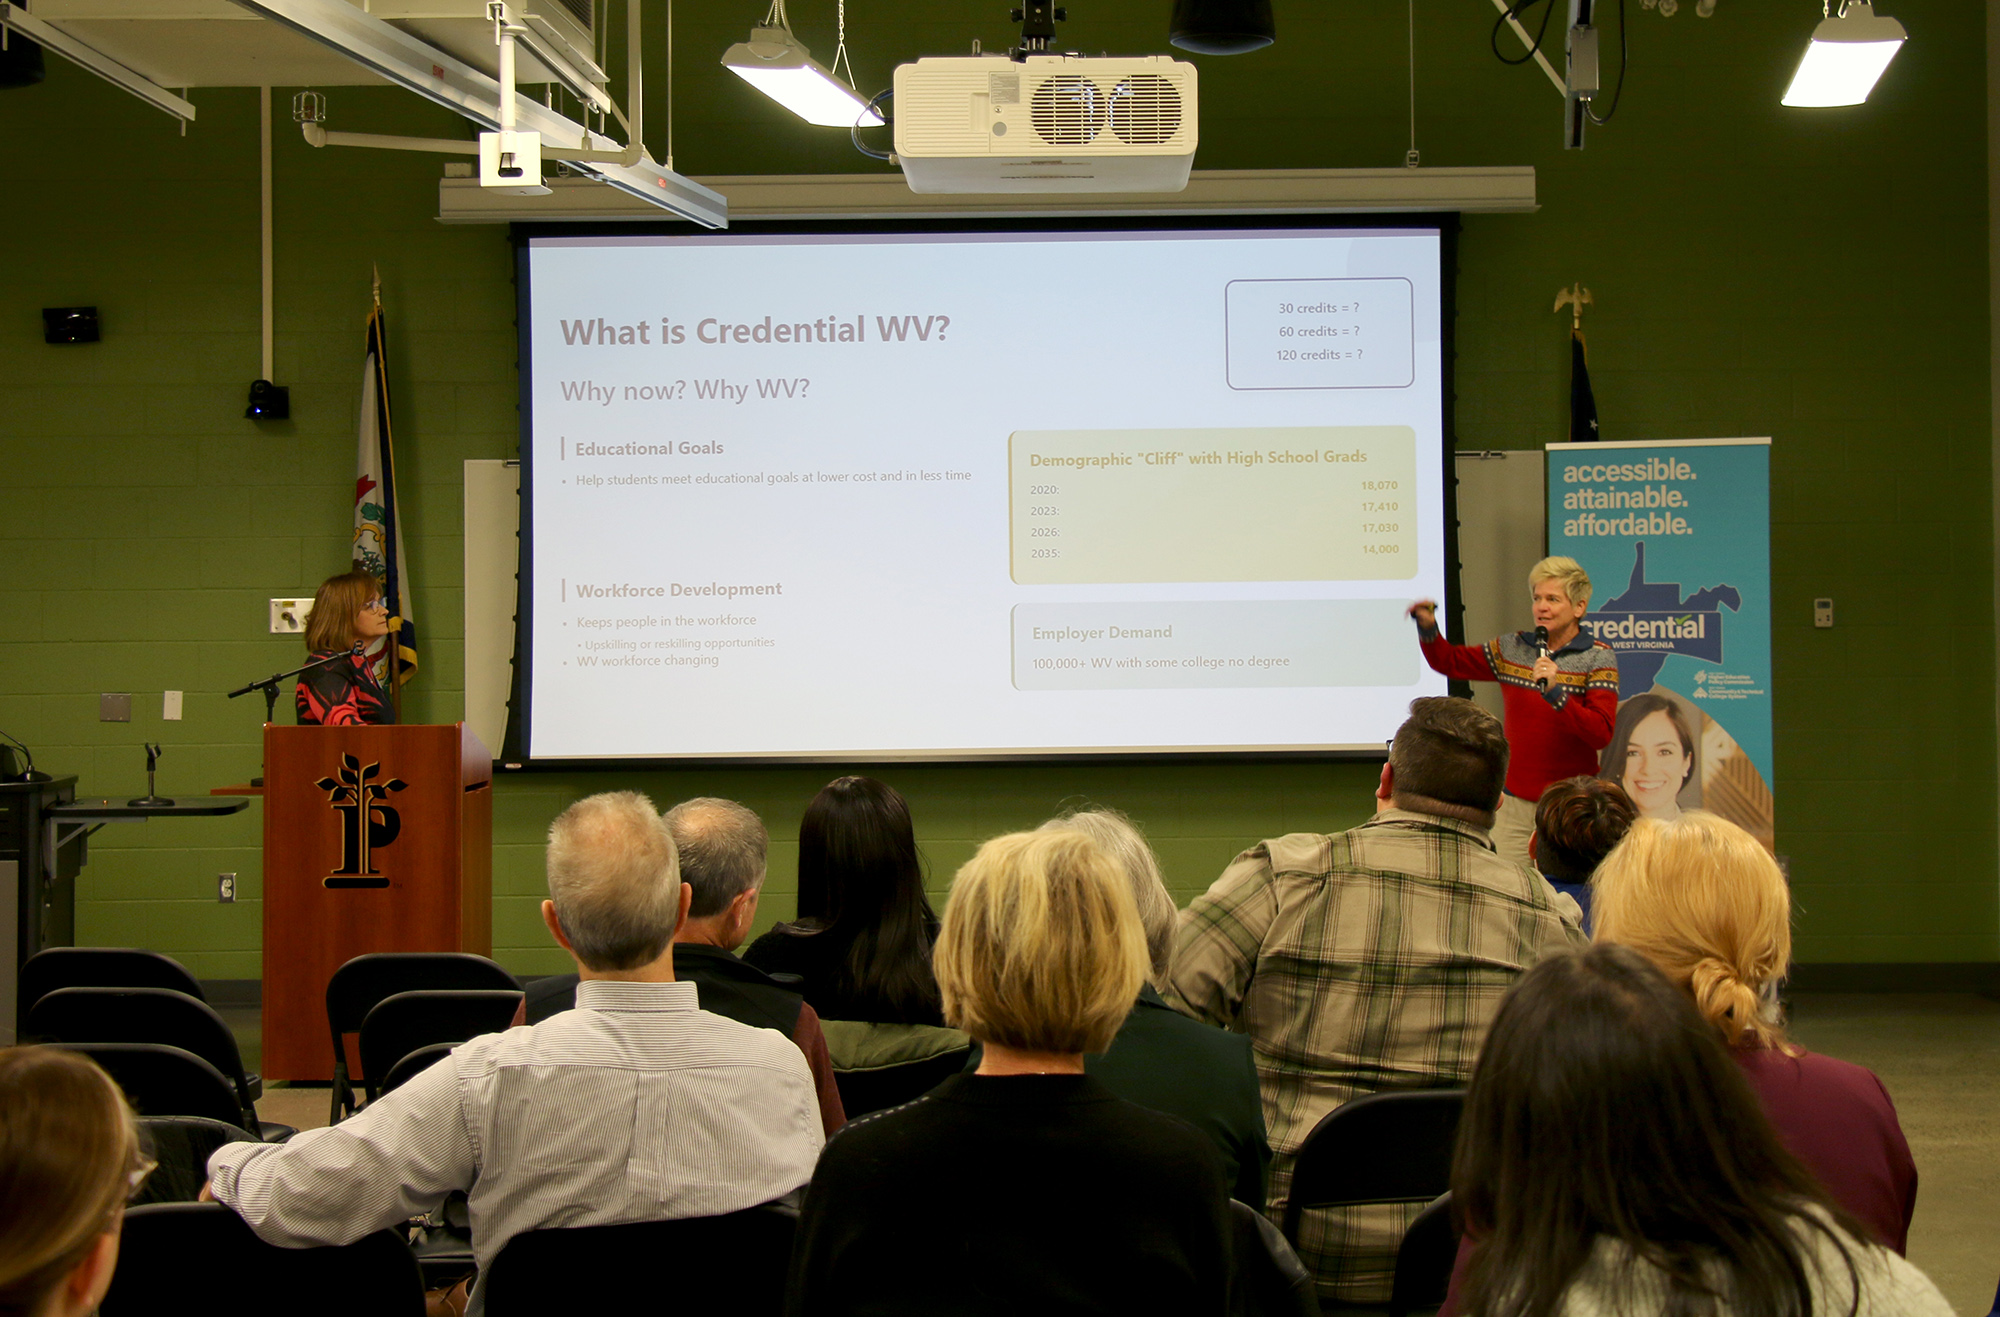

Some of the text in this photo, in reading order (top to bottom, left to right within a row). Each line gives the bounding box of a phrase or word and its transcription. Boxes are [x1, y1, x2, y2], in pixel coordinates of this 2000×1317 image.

[1279, 303, 1294, 314] 30
[1297, 302, 1337, 313] credits
[1354, 302, 1359, 312] ?
[560, 315, 950, 345] What is Credential WV?
[1279, 326, 1295, 337] 60
[1298, 326, 1337, 336] credits
[1354, 326, 1360, 336] ?
[1277, 350, 1297, 360] 120
[1301, 349, 1340, 360] credits
[1357, 349, 1363, 359] ?
[561, 378, 810, 406] Why now? Why WV?
[576, 440, 723, 456] Educational Goals
[1031, 449, 1367, 469] Demographic "Cliff" with High School Grads
[1563, 457, 1697, 483] accessible.
[577, 470, 971, 488] Help students meet educational goals at lower cost and in less time
[1031, 481, 1398, 494] 2020: 18,070
[1563, 484, 1689, 509] attainable.
[1031, 502, 1398, 515] 2023: 17,410
[1031, 523, 1399, 537] 2026: 17,030
[1564, 512, 1692, 536] affordable.
[1032, 545, 1399, 558] 2035: 14,000
[576, 582, 782, 600] Workforce Development
[578, 614, 756, 630] Keeps people in the workforce
[1033, 625, 1172, 642] Employer Demand
[585, 637, 775, 652] Upskilling or reskilling opportunities
[1611, 641, 1675, 649] WEST VIRGINIA
[577, 653, 719, 668] WV workforce changing
[1033, 658, 1086, 670] 100,000+
[1091, 658, 1112, 668] WV
[1116, 657, 1141, 668] with
[1182, 656, 1224, 669] college
[1248, 655, 1289, 669] degree
